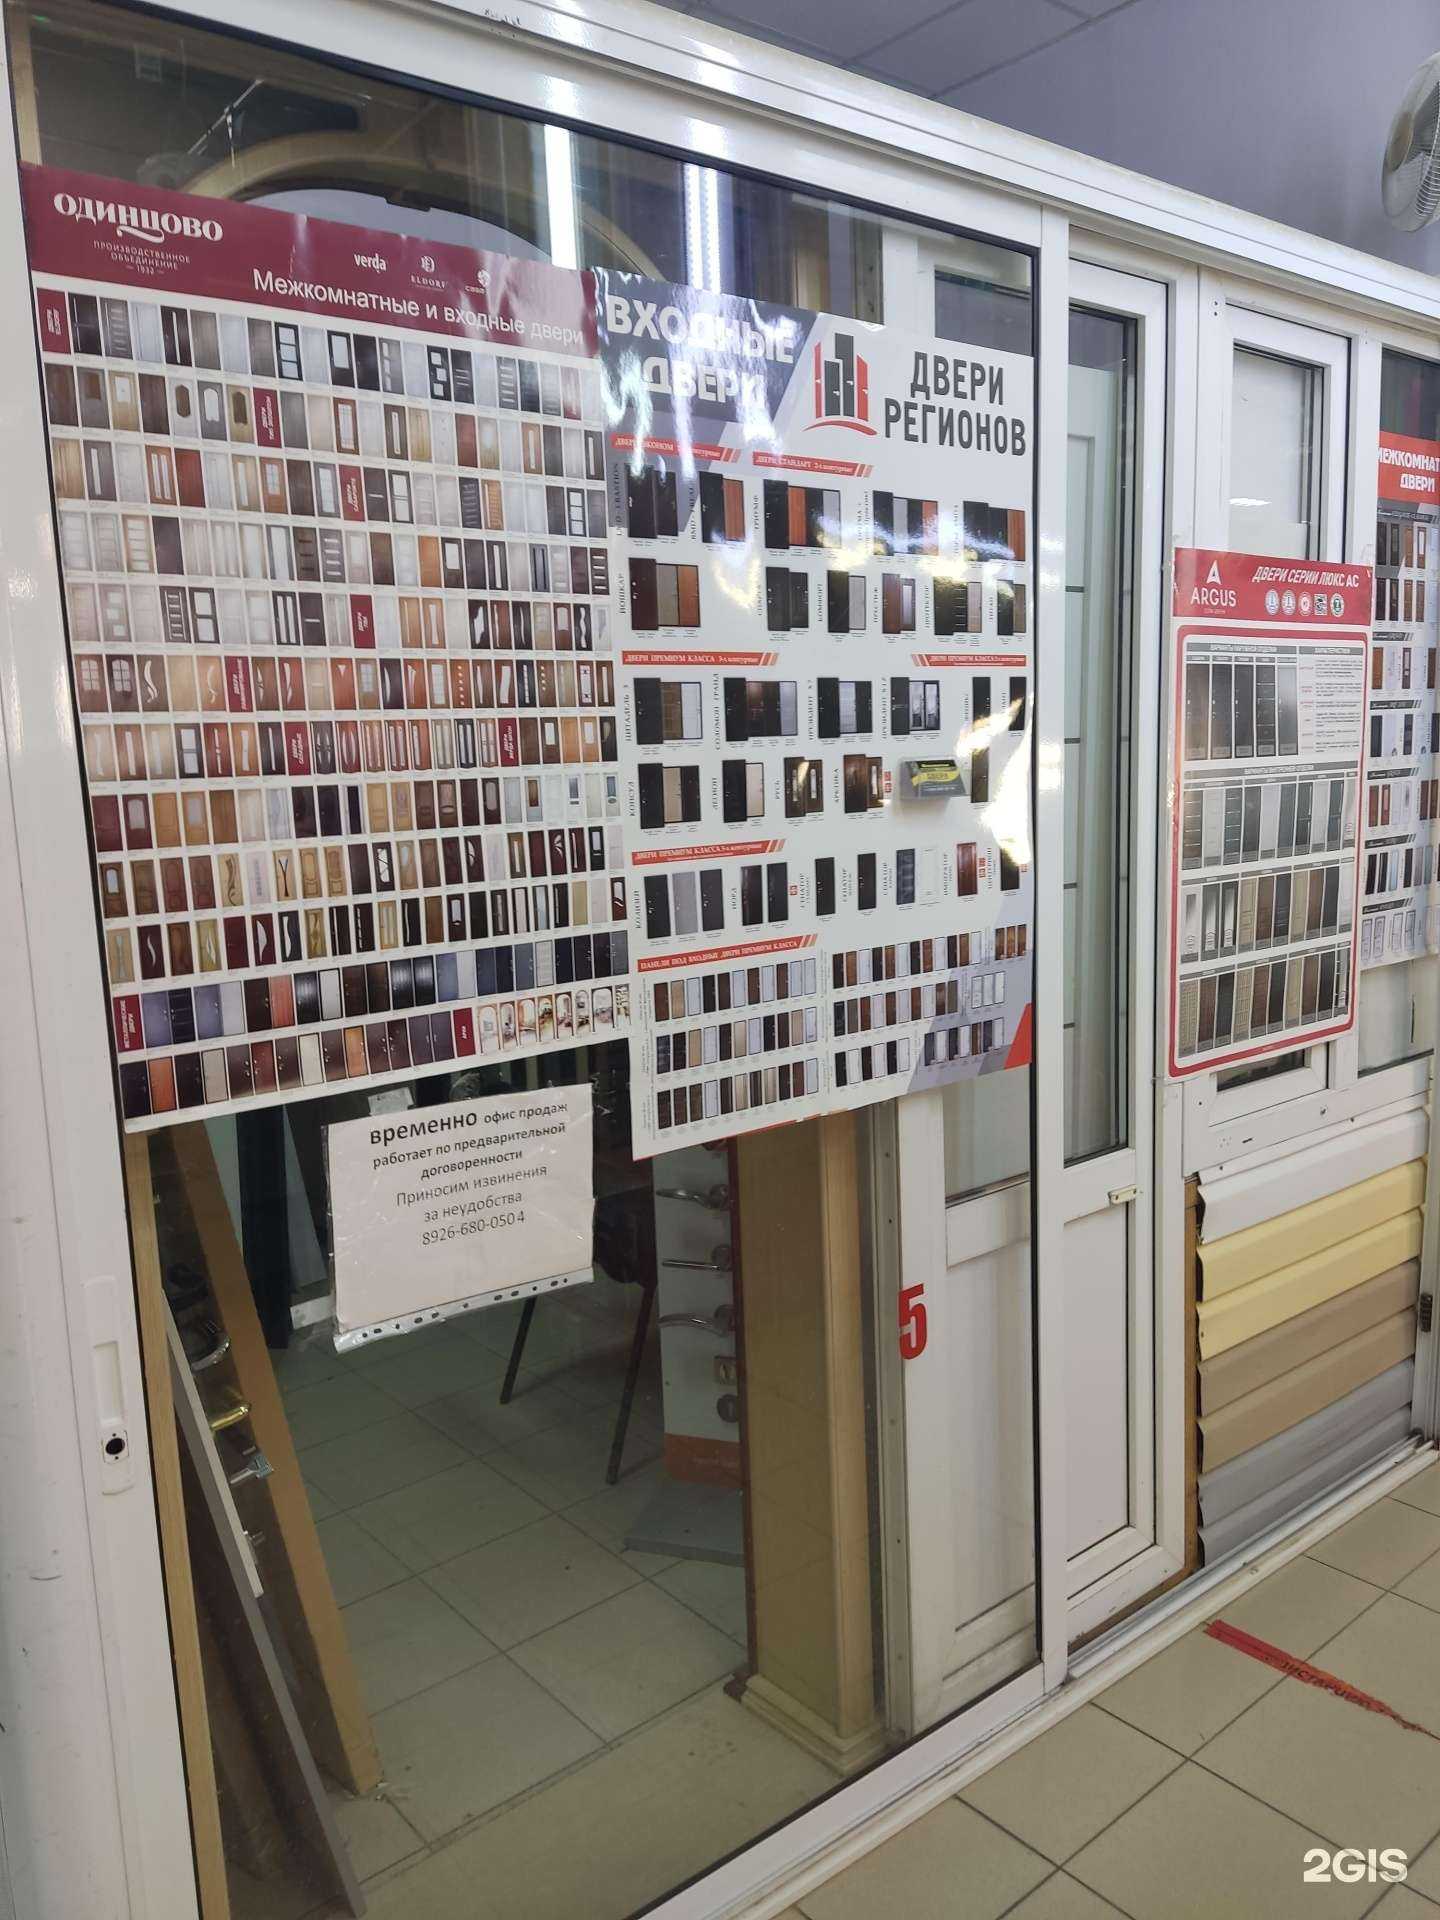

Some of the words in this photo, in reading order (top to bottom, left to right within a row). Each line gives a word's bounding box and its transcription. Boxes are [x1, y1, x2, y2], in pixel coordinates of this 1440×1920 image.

[53, 193, 223, 243] ОДИНЦОВО
[93, 239, 191, 264] ПРОИЗВОДСТВЕННОЕ
[110, 252, 178, 271] ОБЪЕДИНЕНИЕ
[354, 252, 387, 273] verda
[253, 268, 419, 317] Межкомнатные
[426, 307, 438, 320] и
[444, 308, 526, 334] входные
[530, 320, 584, 345] двери
[606, 294, 794, 364] ВХОДНЫЕ
[910, 351, 1004, 406] ДВЕРИ
[884, 397, 1026, 456] РЕГИОНОВ
[1400, 473, 1436, 493] ДВЕРИ
[1252, 566, 1287, 583] ДВЕРИ
[1287, 569, 1319, 586] СЕРИИ
[1318, 570, 1345, 587] ЛЮКС
[1190, 586, 1237, 607] ARGUS
[369, 1111, 477, 1147] временно
[484, 1109, 516, 1126] офис
[519, 1103, 568, 1120] продаж
[373, 1147, 432, 1170] работает
[436, 1144, 451, 1156] по
[454, 1123, 566, 1153] предварительной
[421, 1149, 523, 1181] договоренности
[396, 1181, 469, 1207] Приносим
[474, 1164, 548, 1190] извинения
[423, 1210, 439, 1223] за
[443, 1191, 522, 1219] неудобства
[422, 1210, 526, 1245] 8926-680-0504
[898, 1283, 927, 1360] 5
